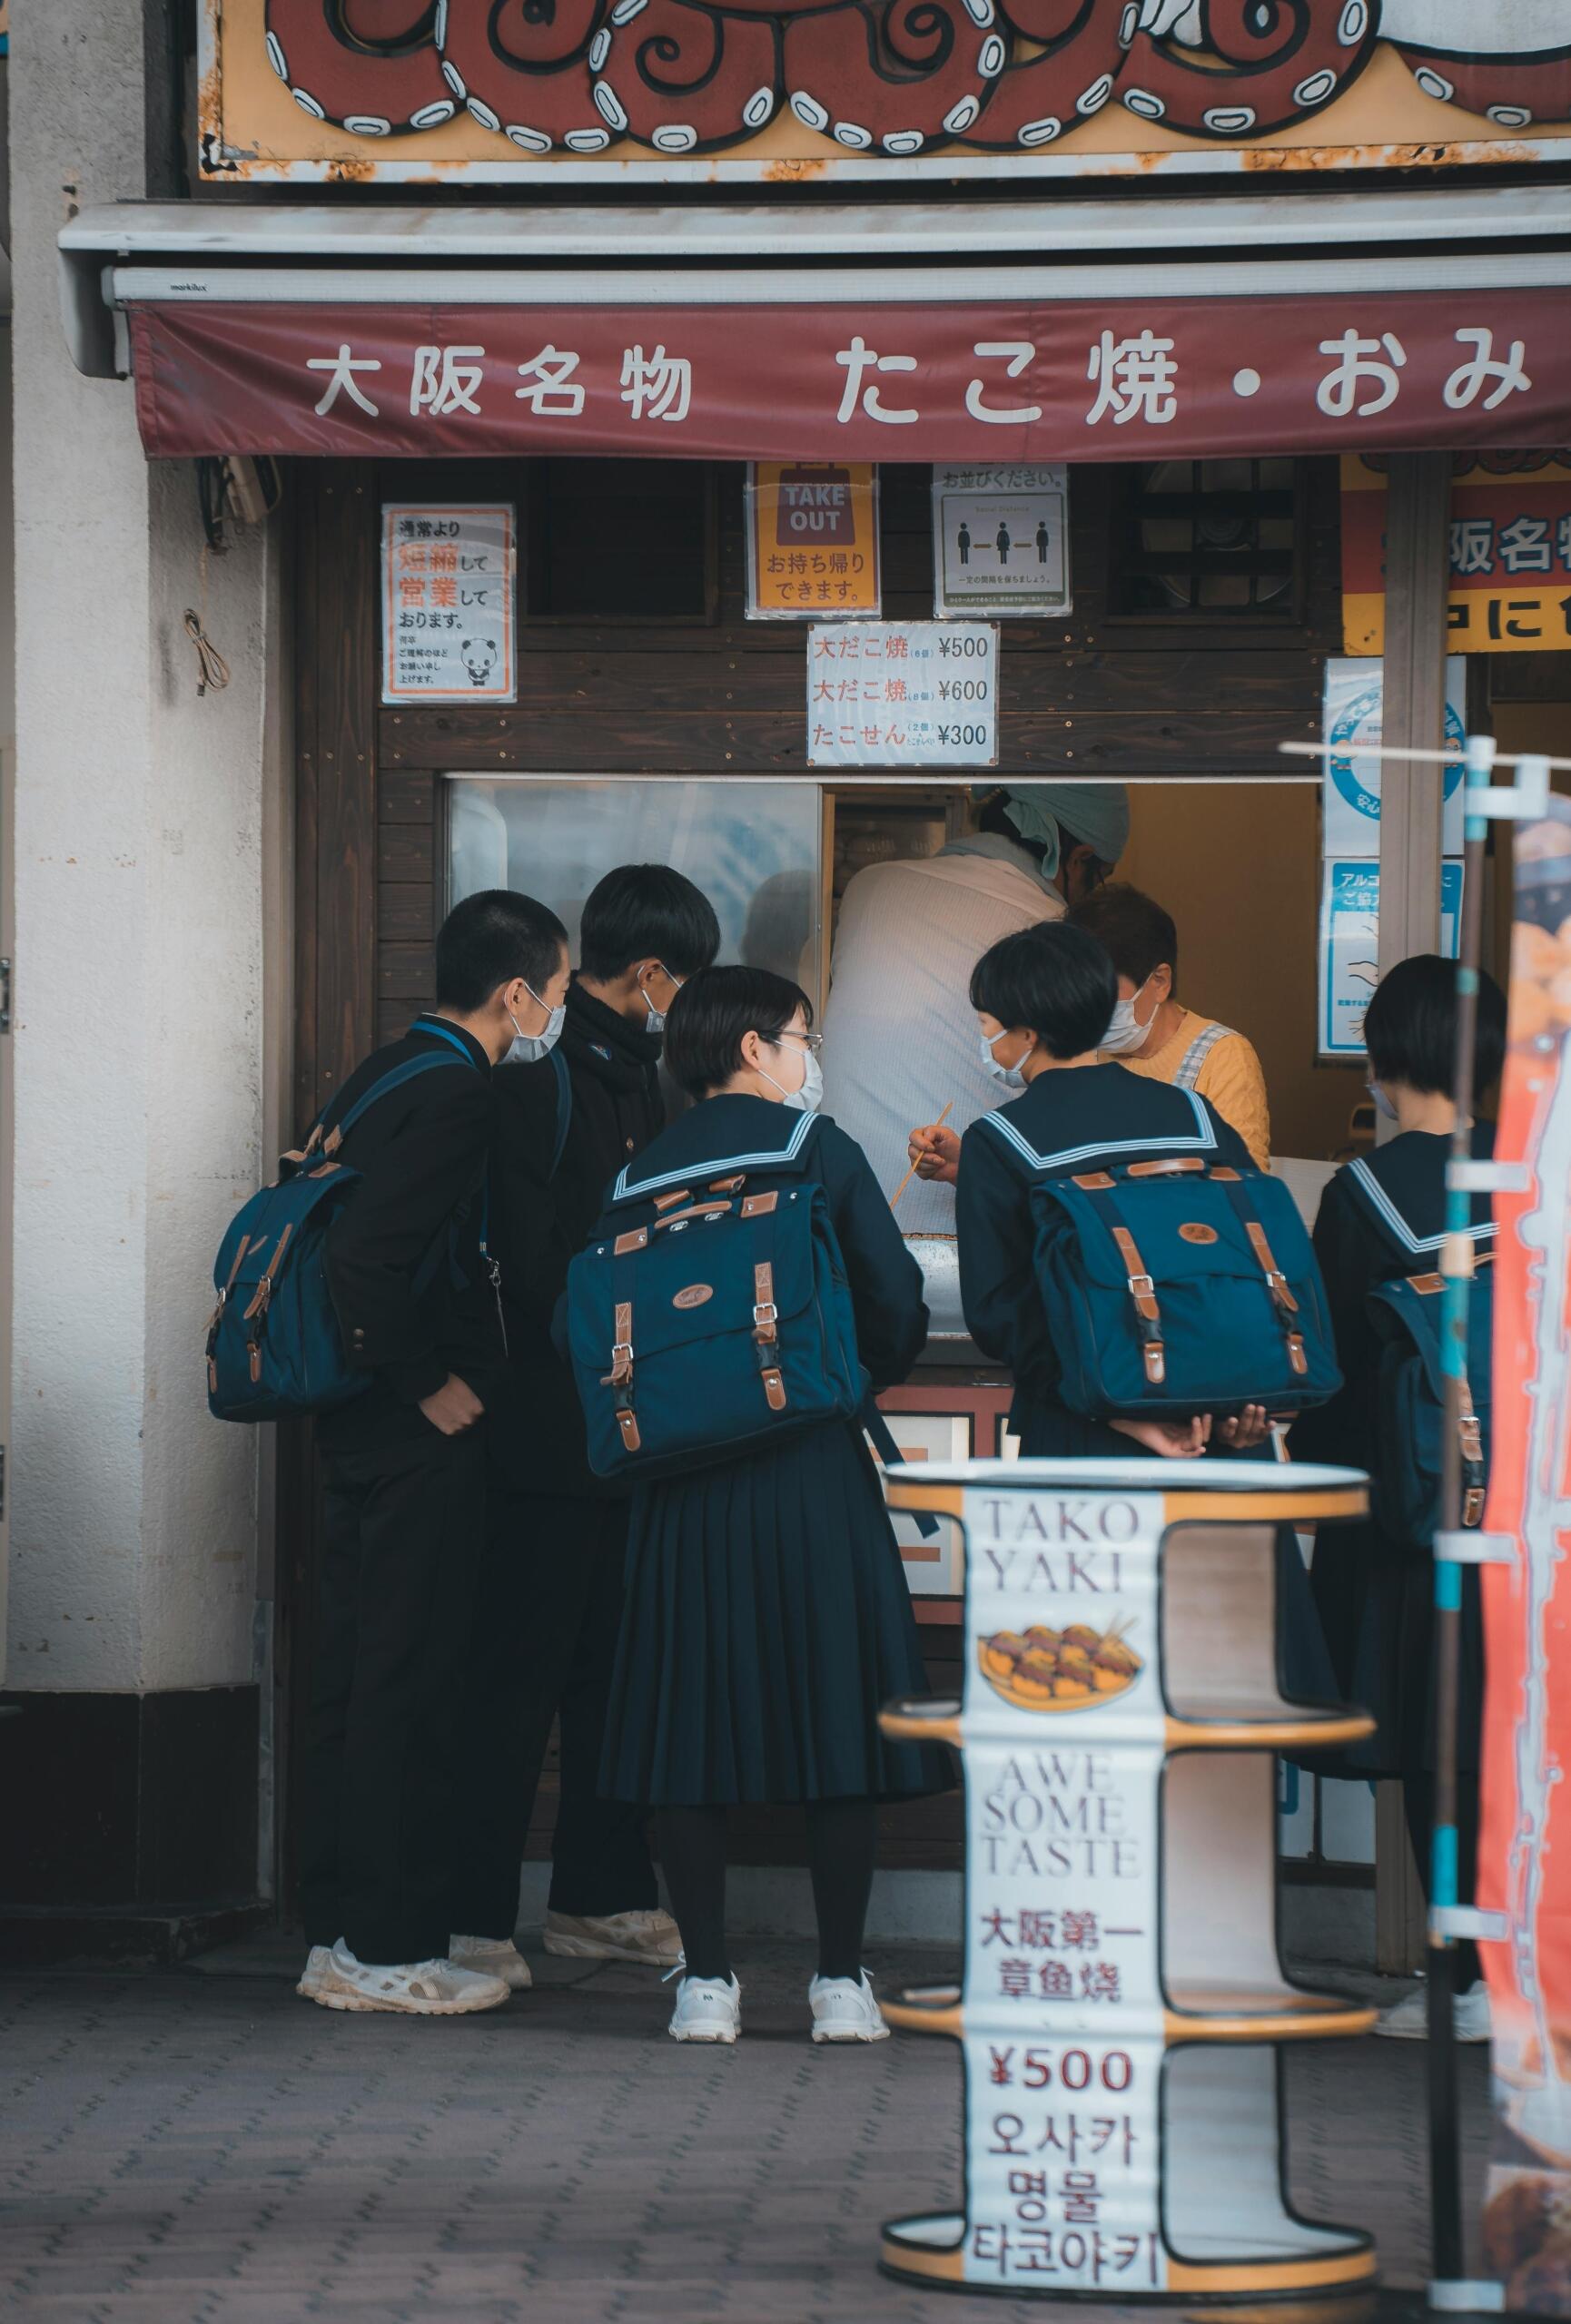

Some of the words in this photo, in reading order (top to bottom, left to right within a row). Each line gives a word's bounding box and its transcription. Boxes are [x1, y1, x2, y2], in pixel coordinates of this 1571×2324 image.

[306, 344, 691, 421] 大阪名物
[785, 486, 845, 507] TAKE
[400, 520, 459, 537] 通常より
[790, 511, 840, 531] OUT
[399, 542, 488, 572] 短縮して
[767, 552, 864, 575] お持ち帰り
[400, 576, 488, 607] 営業して
[776, 580, 858, 601] できます。
[400, 612, 462, 629] おります。
[814, 635, 908, 659] 大だこ焼
[939, 637, 988, 657] ¥500
[814, 679, 907, 702] 大だこ焼
[939, 681, 988, 701] ¥600
[814, 724, 906, 745] たこせん
[938, 725, 987, 745] ¥300
[983, 1500, 1140, 1541] TAKO
[983, 1549, 1127, 1594] YAKI
[996, 1754, 1115, 1793] AWE
[983, 1794, 1127, 1837] SOME
[982, 1837, 1142, 1879] TASTE
[981, 1906, 1144, 1952] 大阪第一
[999, 1959, 1121, 2004] 章鱼烧
[990, 2044, 1133, 2090] ¥500
[988, 2112, 1139, 2165] 오사카
[1009, 2170, 1104, 2224] 명물
[972, 2223, 1159, 2284] 타코야키
